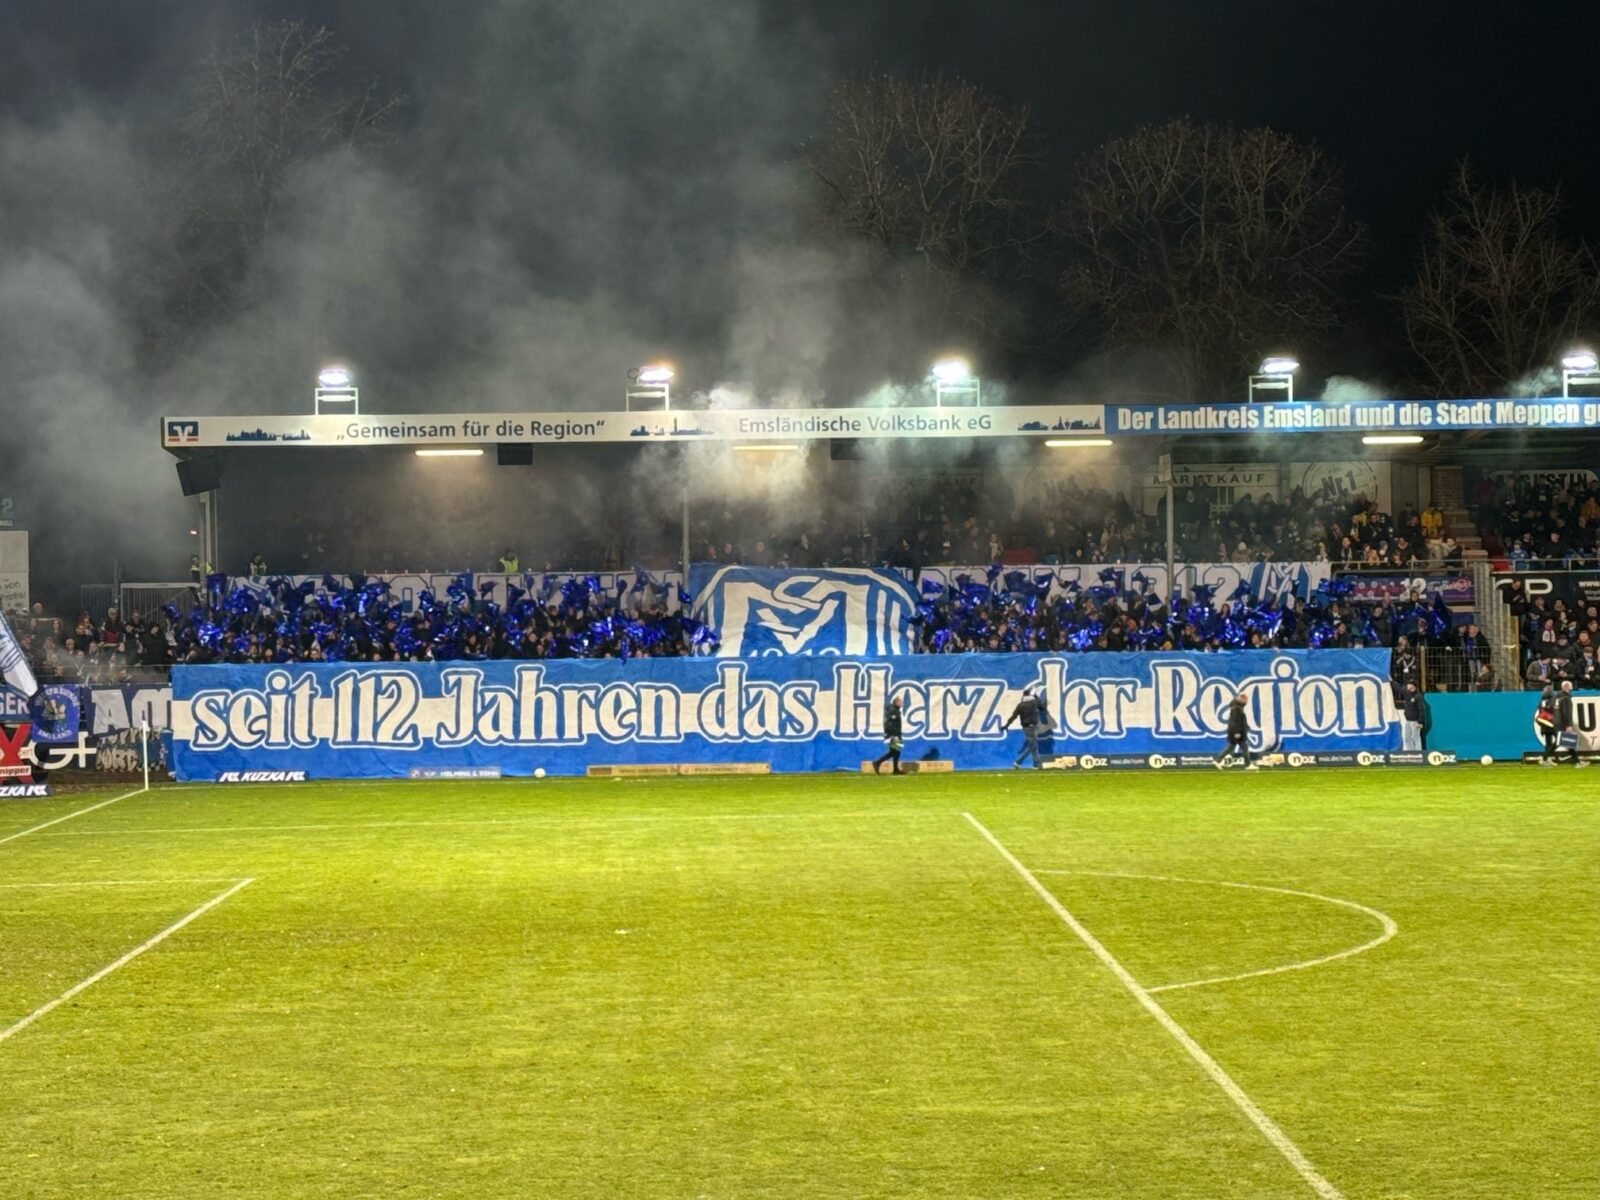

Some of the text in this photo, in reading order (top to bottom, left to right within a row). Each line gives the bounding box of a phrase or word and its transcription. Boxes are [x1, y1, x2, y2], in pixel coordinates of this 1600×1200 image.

[738, 414, 992, 433] Emsländische Volksbank eG
[1118, 408, 1153, 430] Der
[1158, 405, 1259, 429] Landkreis
[1263, 404, 1350, 428] Emsland
[1355, 403, 1395, 426] und
[1399, 403, 1432, 425] die
[1436, 402, 1492, 425] Stadt
[1496, 402, 1580, 425] Meppen
[463, 420, 490, 437] für
[496, 420, 524, 437] die
[192, 657, 1387, 751] seit 112 Jahren das Herz der Region
